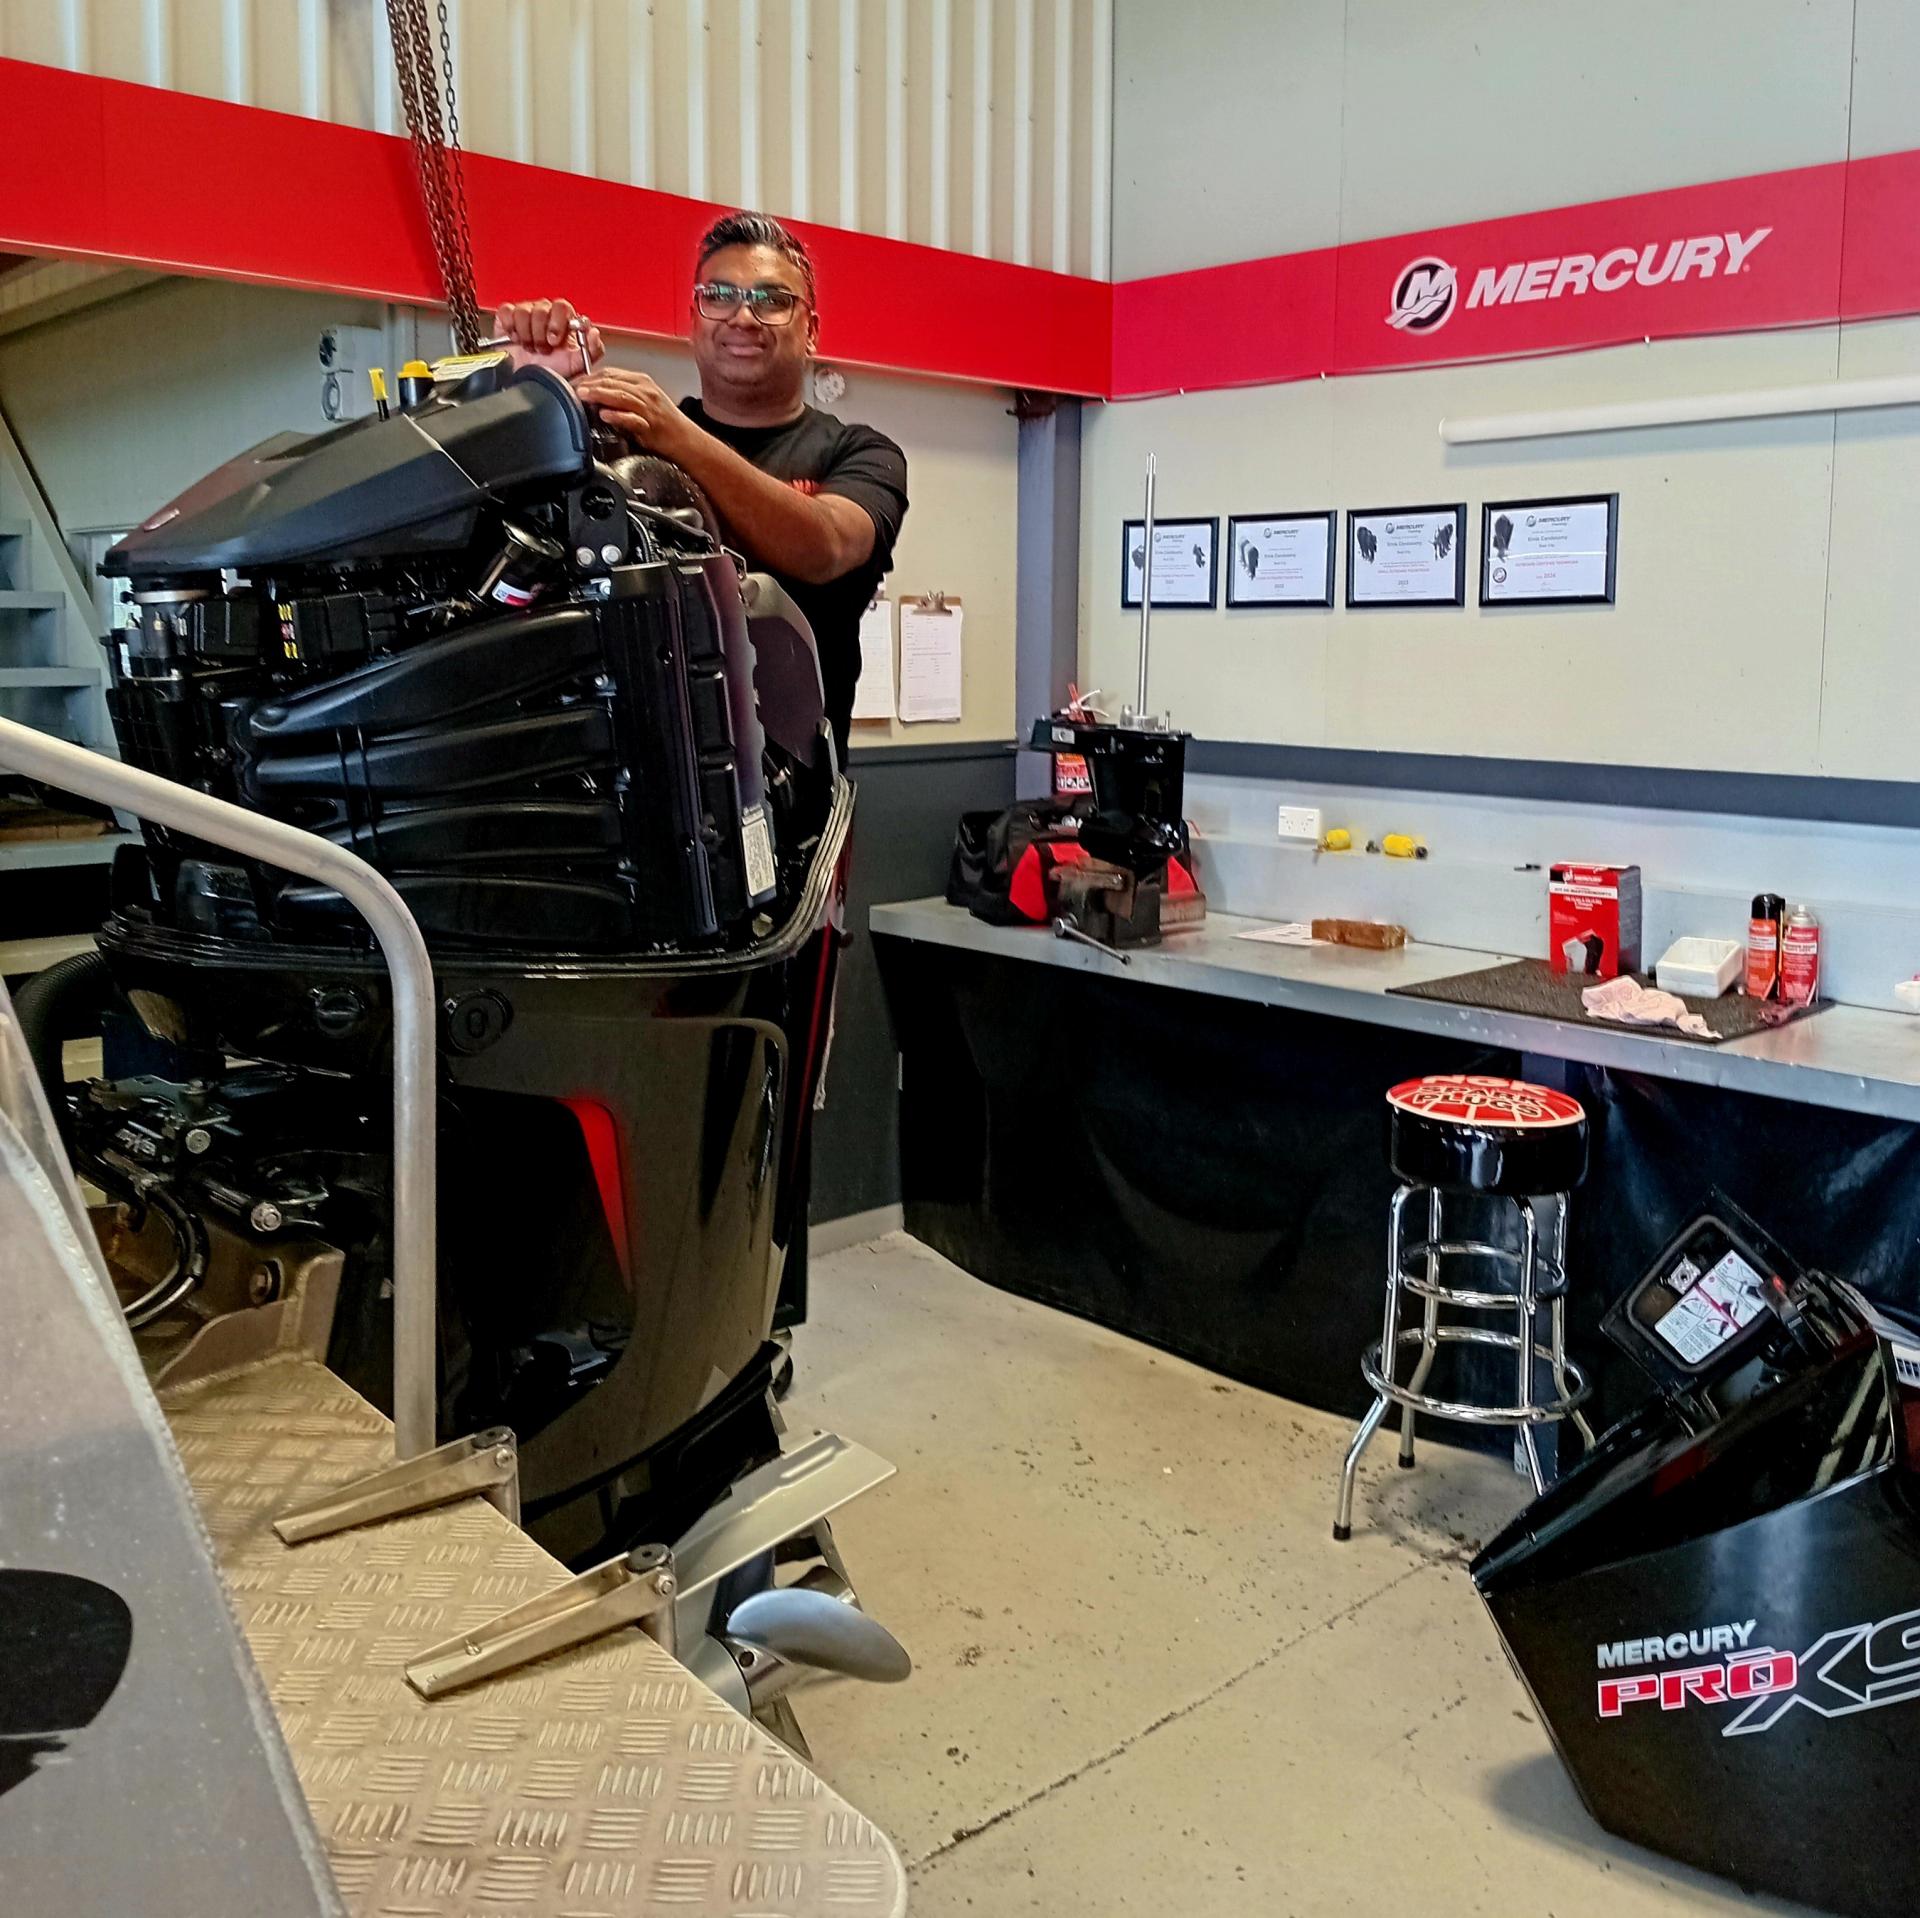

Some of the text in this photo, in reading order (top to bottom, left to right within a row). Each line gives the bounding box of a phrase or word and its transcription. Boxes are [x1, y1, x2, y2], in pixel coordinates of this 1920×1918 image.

[1464, 227, 1772, 309] MERCURY
[1417, 1085, 1547, 1107] SPARK
[1422, 1074, 1548, 1097] NGK
[1411, 1092, 1543, 1118] PLUGS
[1597, 1618, 1757, 1669] MERCURY
[1598, 1650, 1798, 1718] PRO
